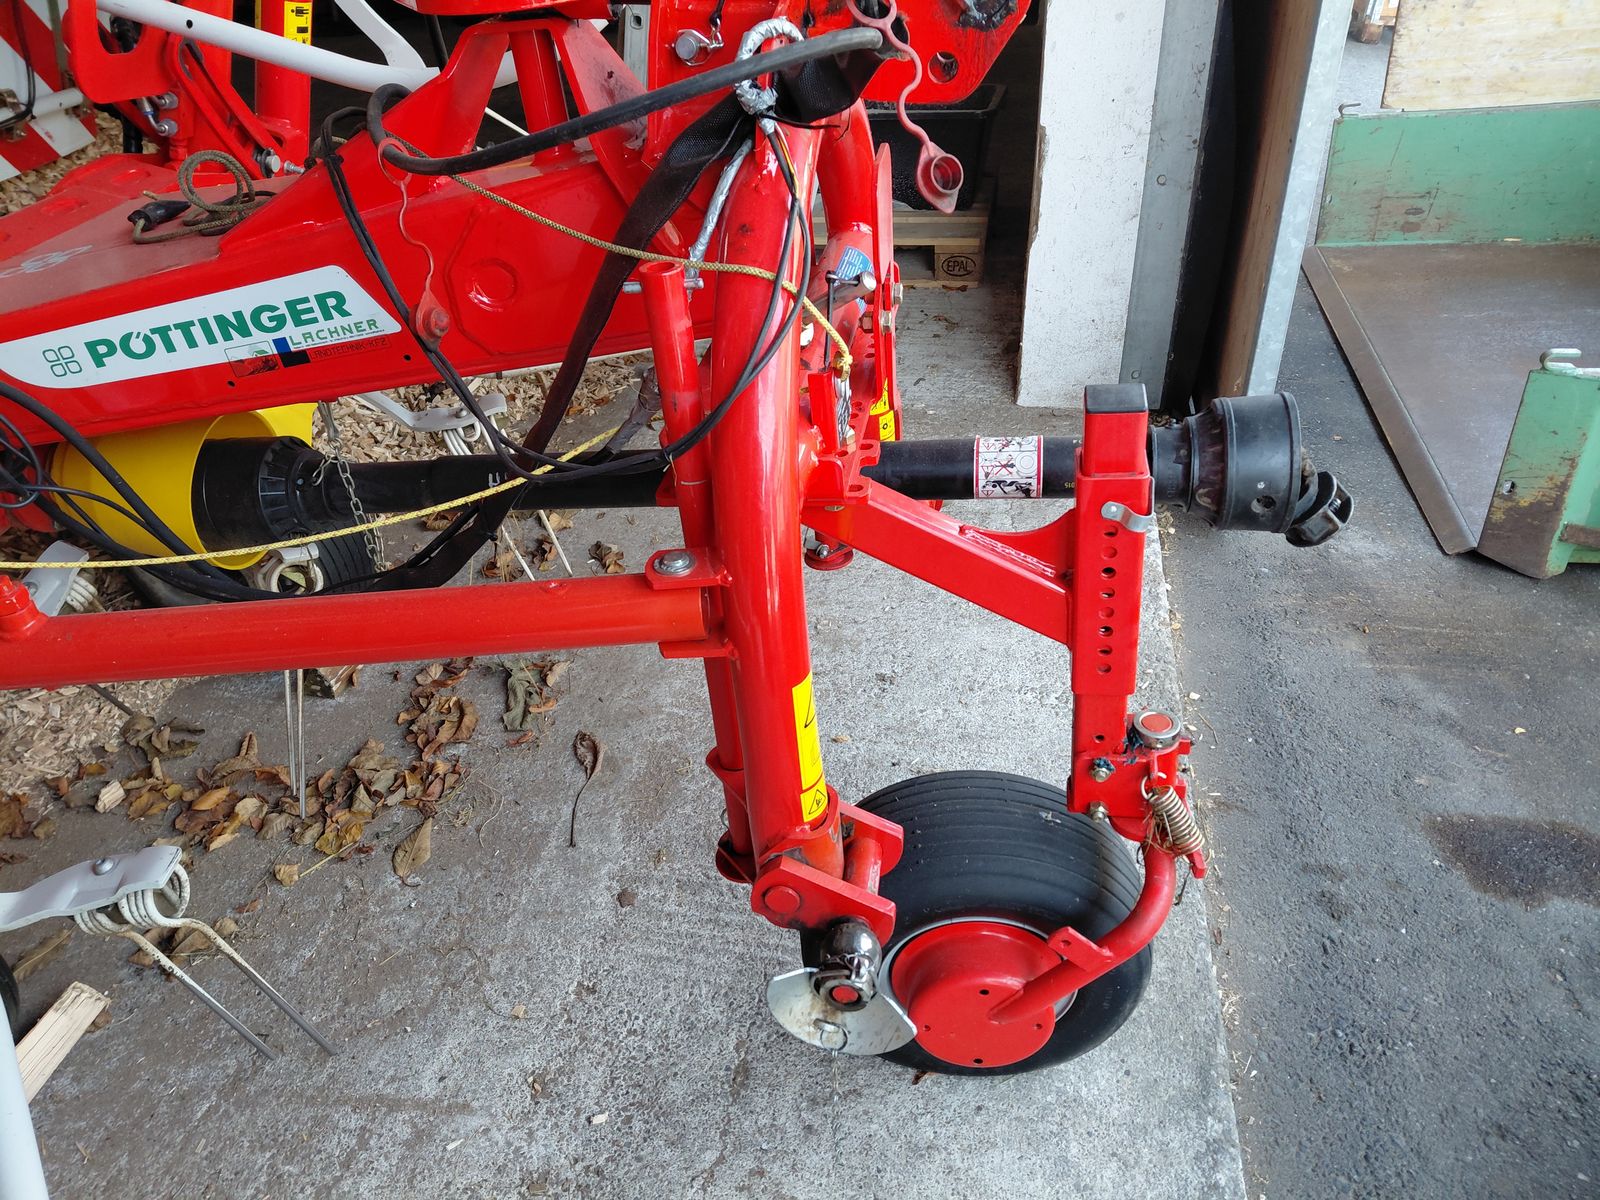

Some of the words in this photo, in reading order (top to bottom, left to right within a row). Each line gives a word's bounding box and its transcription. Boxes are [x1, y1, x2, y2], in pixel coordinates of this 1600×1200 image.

[946, 260, 970, 273] EPAL
[84, 290, 352, 369] PÖTTINGER
[288, 318, 379, 346] LACHNER
